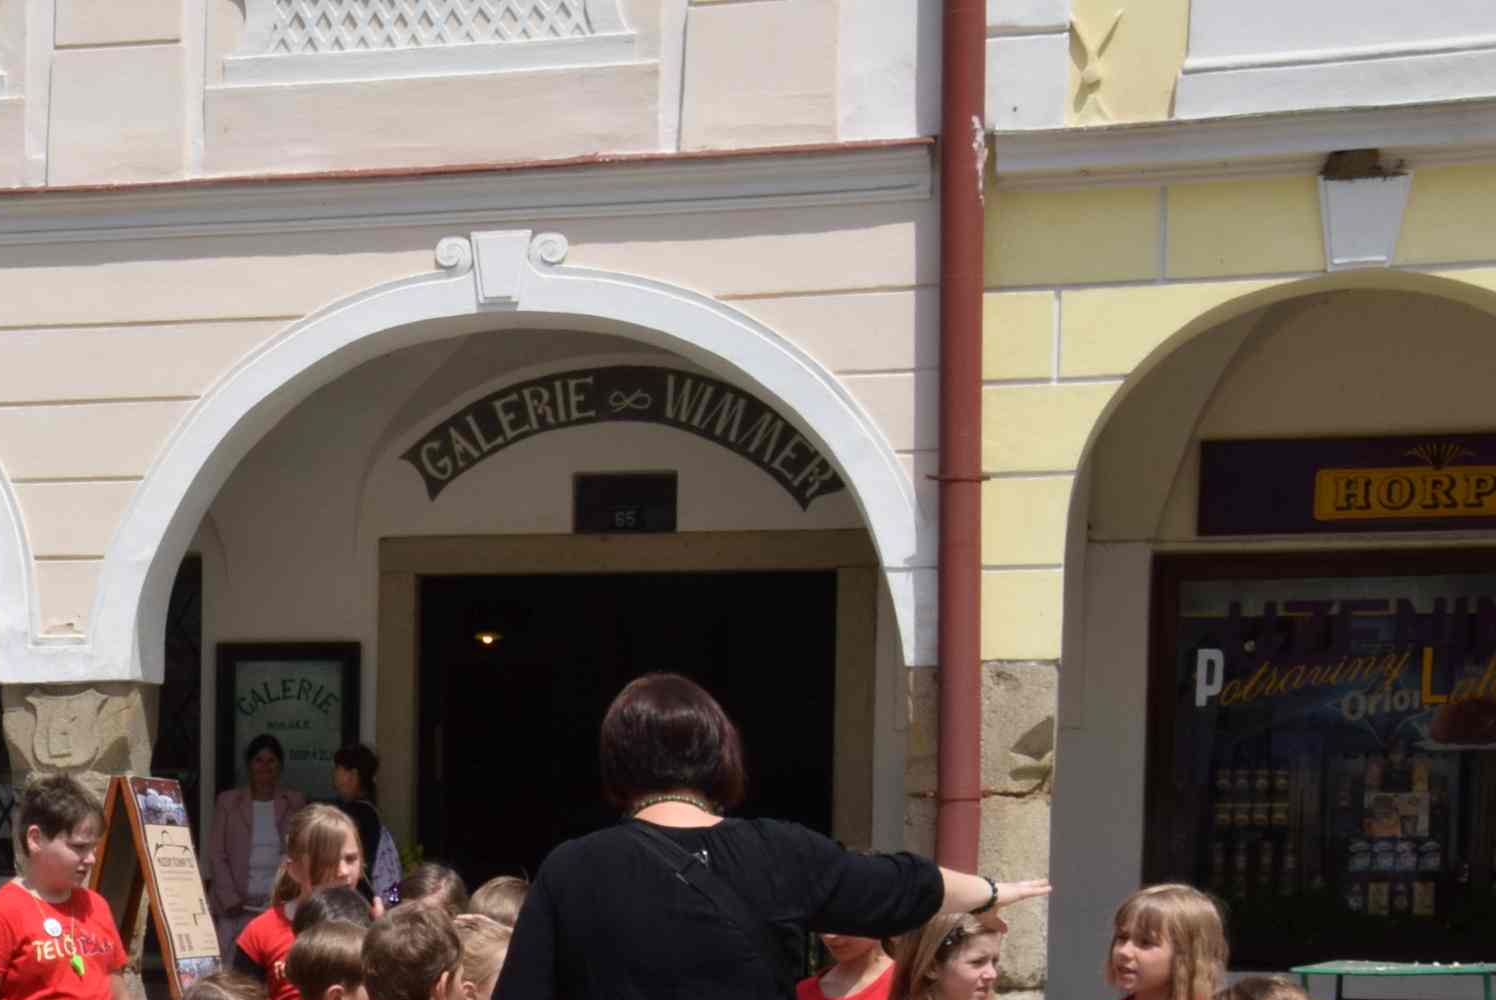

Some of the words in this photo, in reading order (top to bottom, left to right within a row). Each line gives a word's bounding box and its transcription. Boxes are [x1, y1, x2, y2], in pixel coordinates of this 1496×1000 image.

[420, 375, 596, 482] GALERIE
[663, 374, 833, 498] WIMMER
[238, 677, 339, 717] GALERIE
